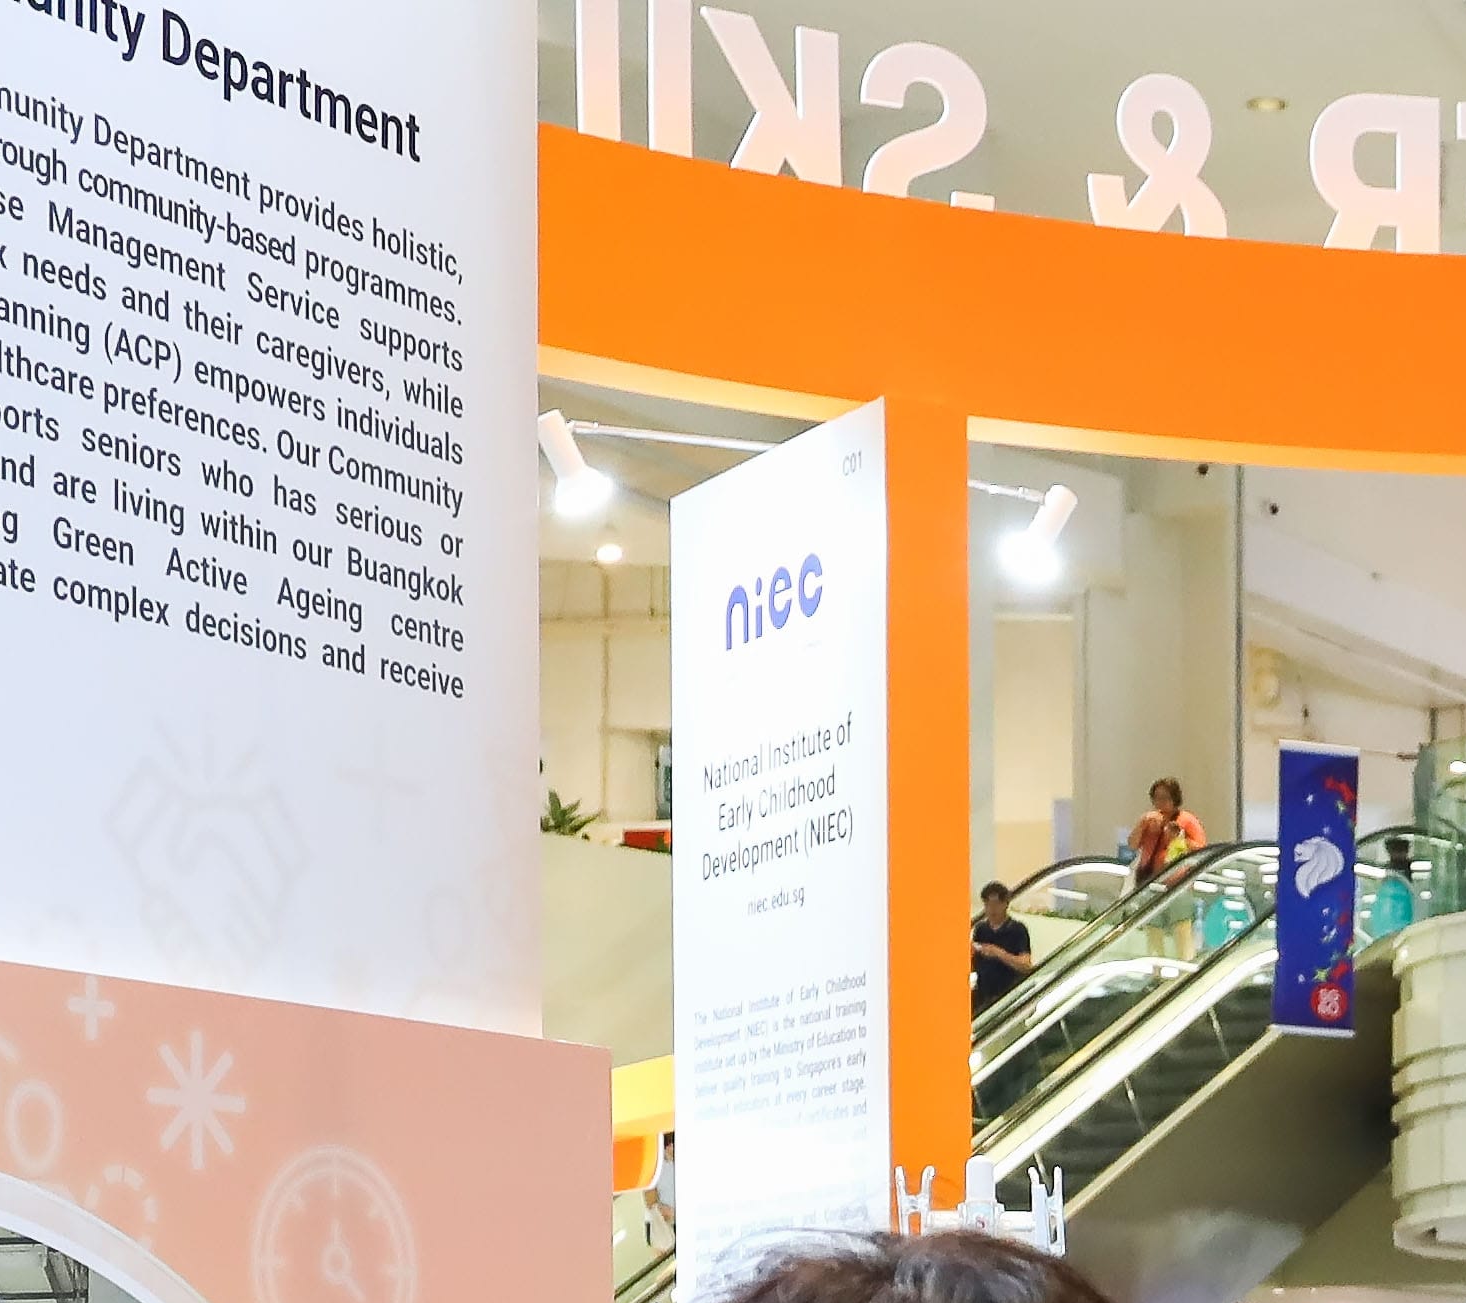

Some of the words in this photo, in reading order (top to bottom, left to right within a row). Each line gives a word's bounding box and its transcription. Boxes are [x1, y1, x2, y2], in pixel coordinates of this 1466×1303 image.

[162, 7, 422, 163] Department
[78, 168, 296, 267] community-based
[305, 249, 462, 326] programmes.
[94, 113, 251, 201] Department
[259, 183, 364, 242] provides
[372, 217, 463, 285] holistic,
[23, 252, 107, 301] needs
[121, 286, 169, 323] and
[183, 299, 243, 345] their
[256, 331, 390, 401] caregivers,
[403, 376, 463, 419] while
[48, 200, 226, 292] Management
[247, 271, 340, 329] Service
[360, 318, 463, 372] supports
[725, 552, 824, 653] niec
[703, 743, 764, 793] National
[768, 726, 832, 771] Institute
[836, 710, 853, 747] of
[718, 795, 754, 832] Early
[759, 763, 835, 819] Childhood
[702, 828, 799, 881] Development
[804, 804, 853, 858] (NIEC)
